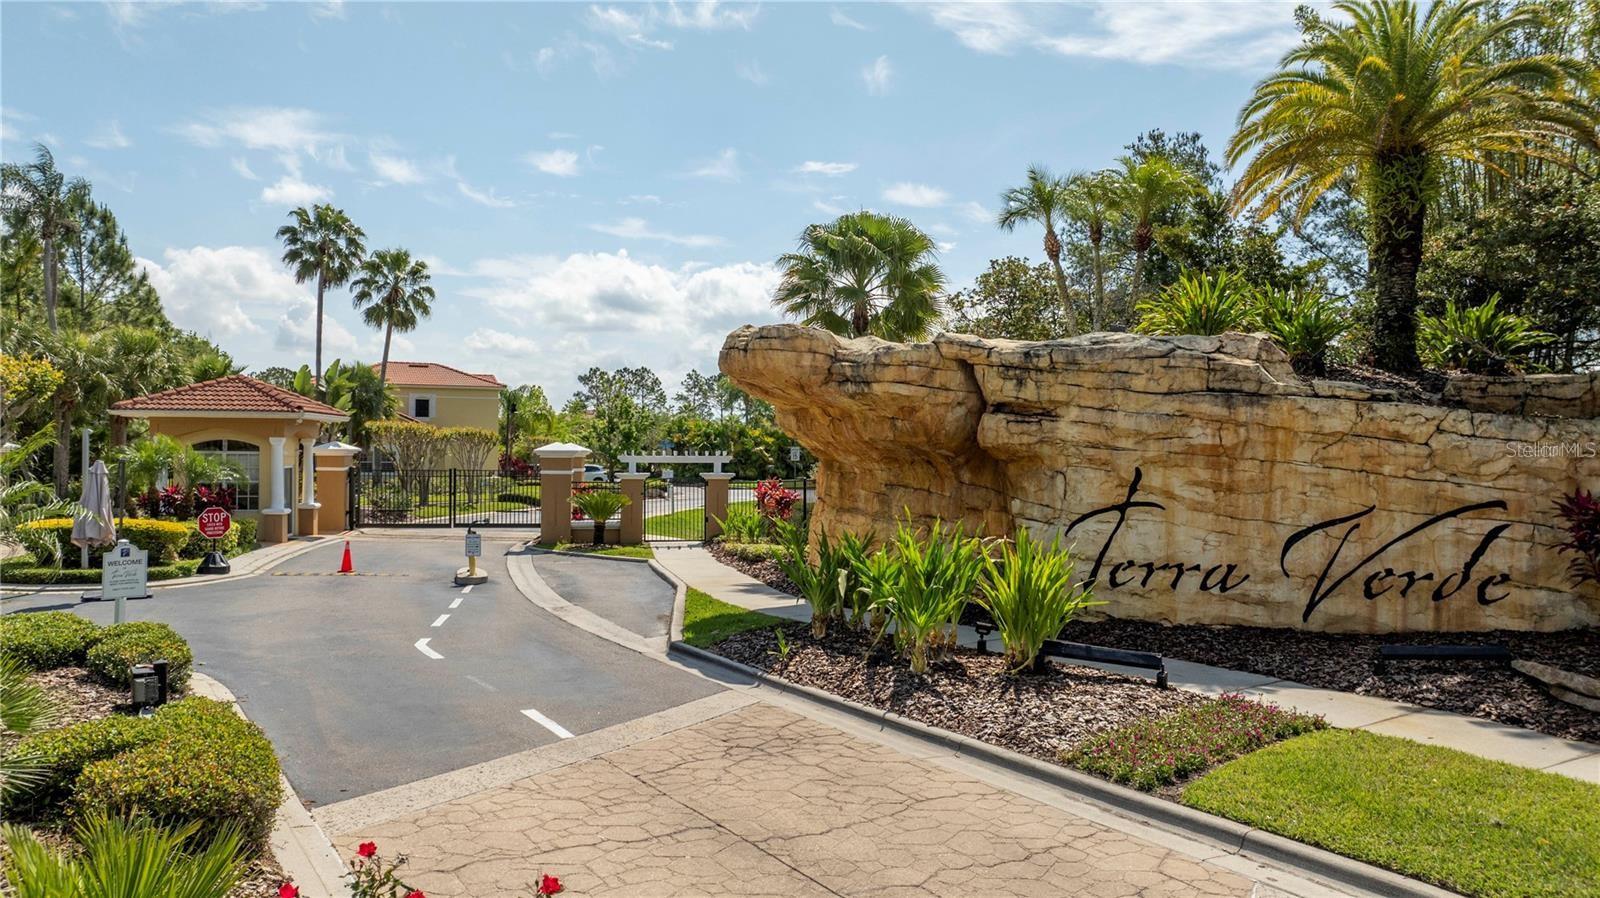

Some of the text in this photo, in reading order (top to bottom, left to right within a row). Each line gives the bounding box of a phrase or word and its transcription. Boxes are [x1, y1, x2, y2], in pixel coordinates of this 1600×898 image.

[202, 512, 227, 523] STOP
[1065, 466, 1512, 623] Terra Verde
[107, 559, 144, 567] WELCOME
